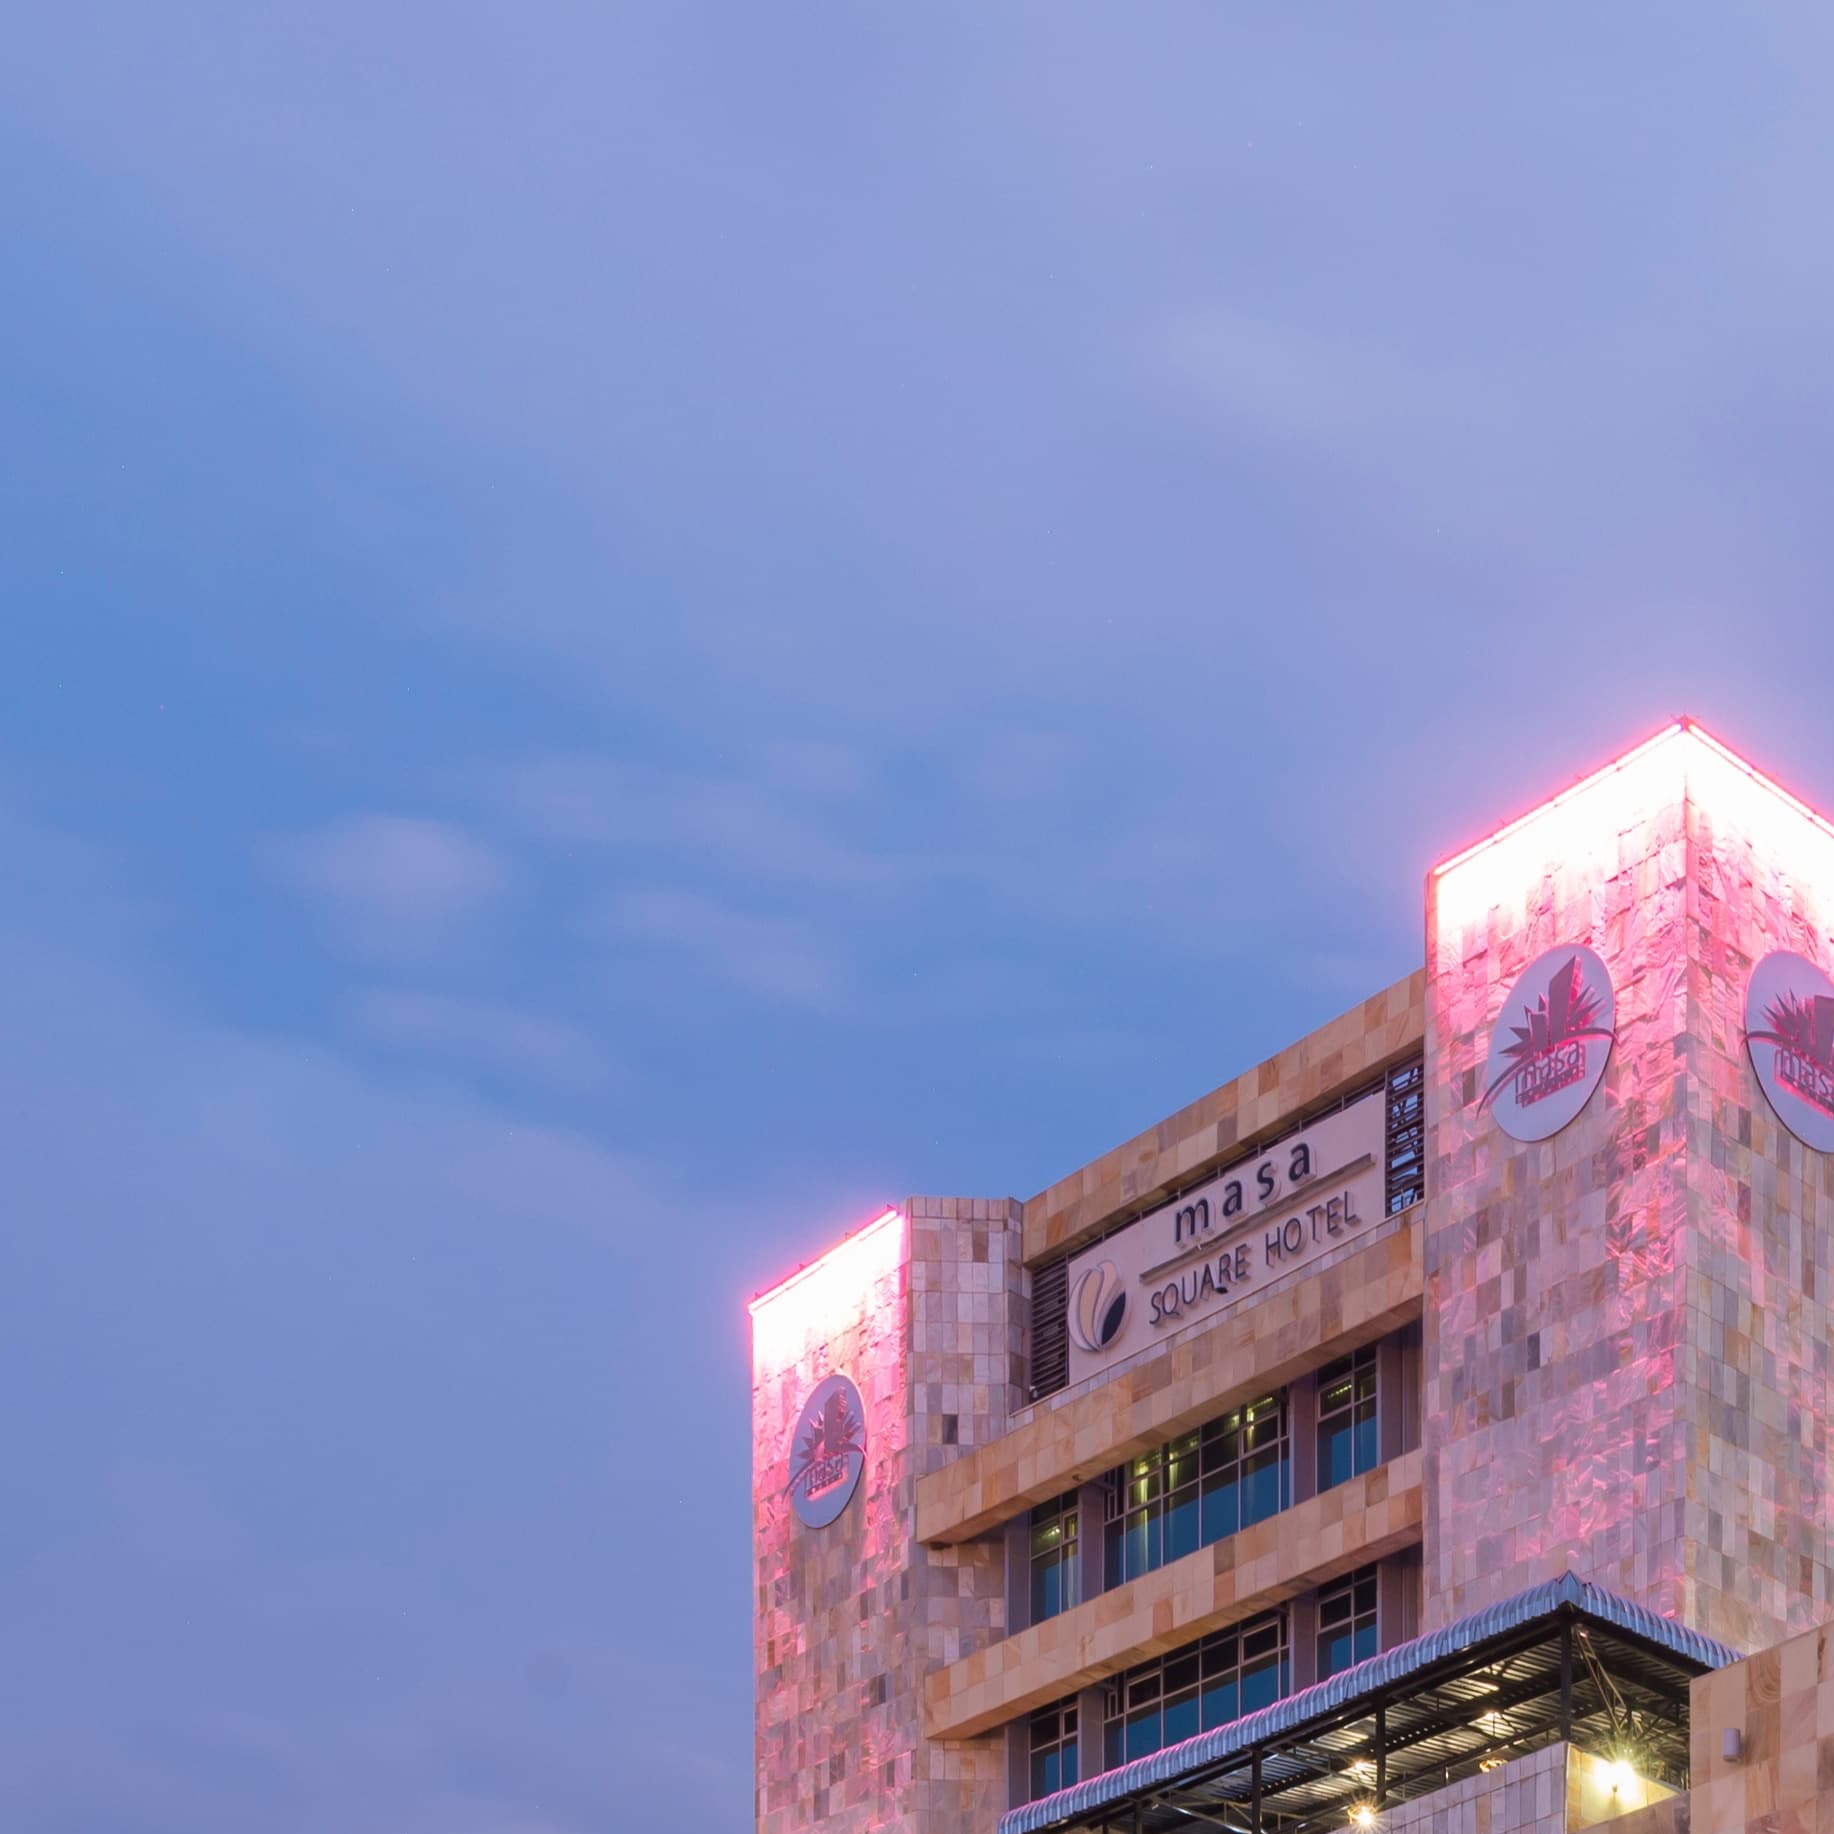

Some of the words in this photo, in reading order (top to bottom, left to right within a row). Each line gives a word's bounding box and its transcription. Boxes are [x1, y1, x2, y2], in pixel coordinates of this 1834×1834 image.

[1175, 1141, 1311, 1243] masa
[1149, 1243, 1249, 1325] SQUARE
[1264, 1190, 1358, 1266] HOTEL
